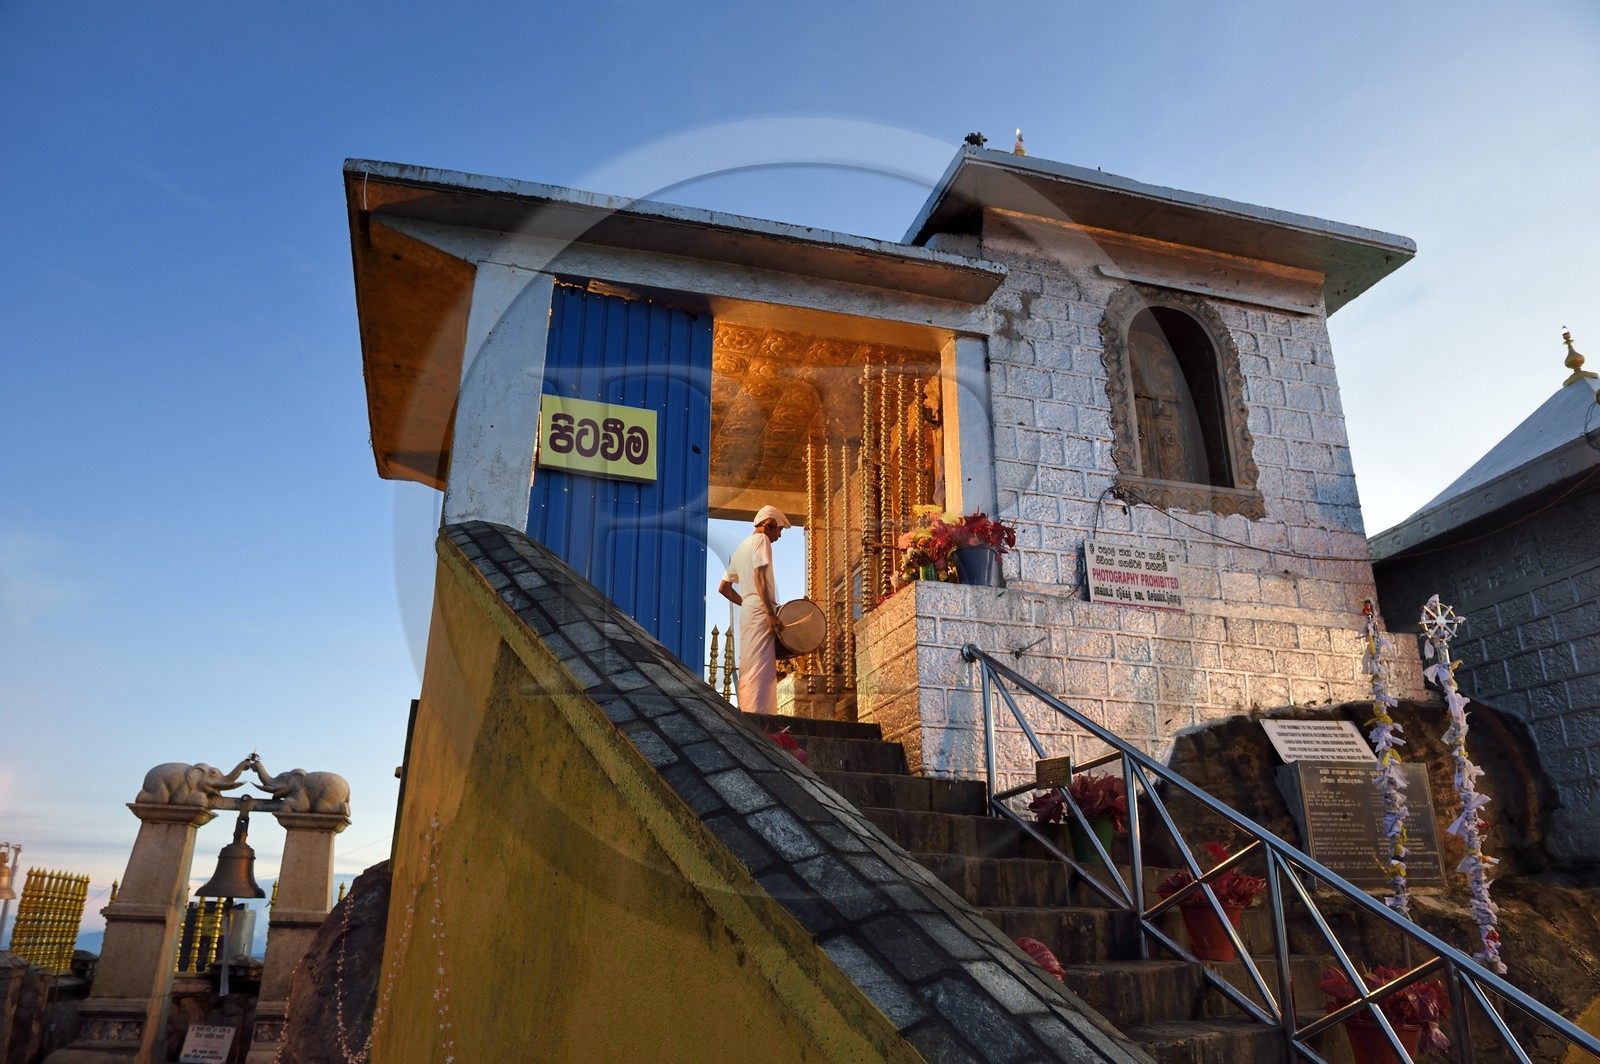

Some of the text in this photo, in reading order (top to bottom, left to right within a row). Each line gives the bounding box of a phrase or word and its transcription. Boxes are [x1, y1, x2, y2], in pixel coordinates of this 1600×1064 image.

[549, 412, 649, 466] පිටවීම
[1092, 568, 1179, 590] PHOTOGRAPHY PROHIBITED
